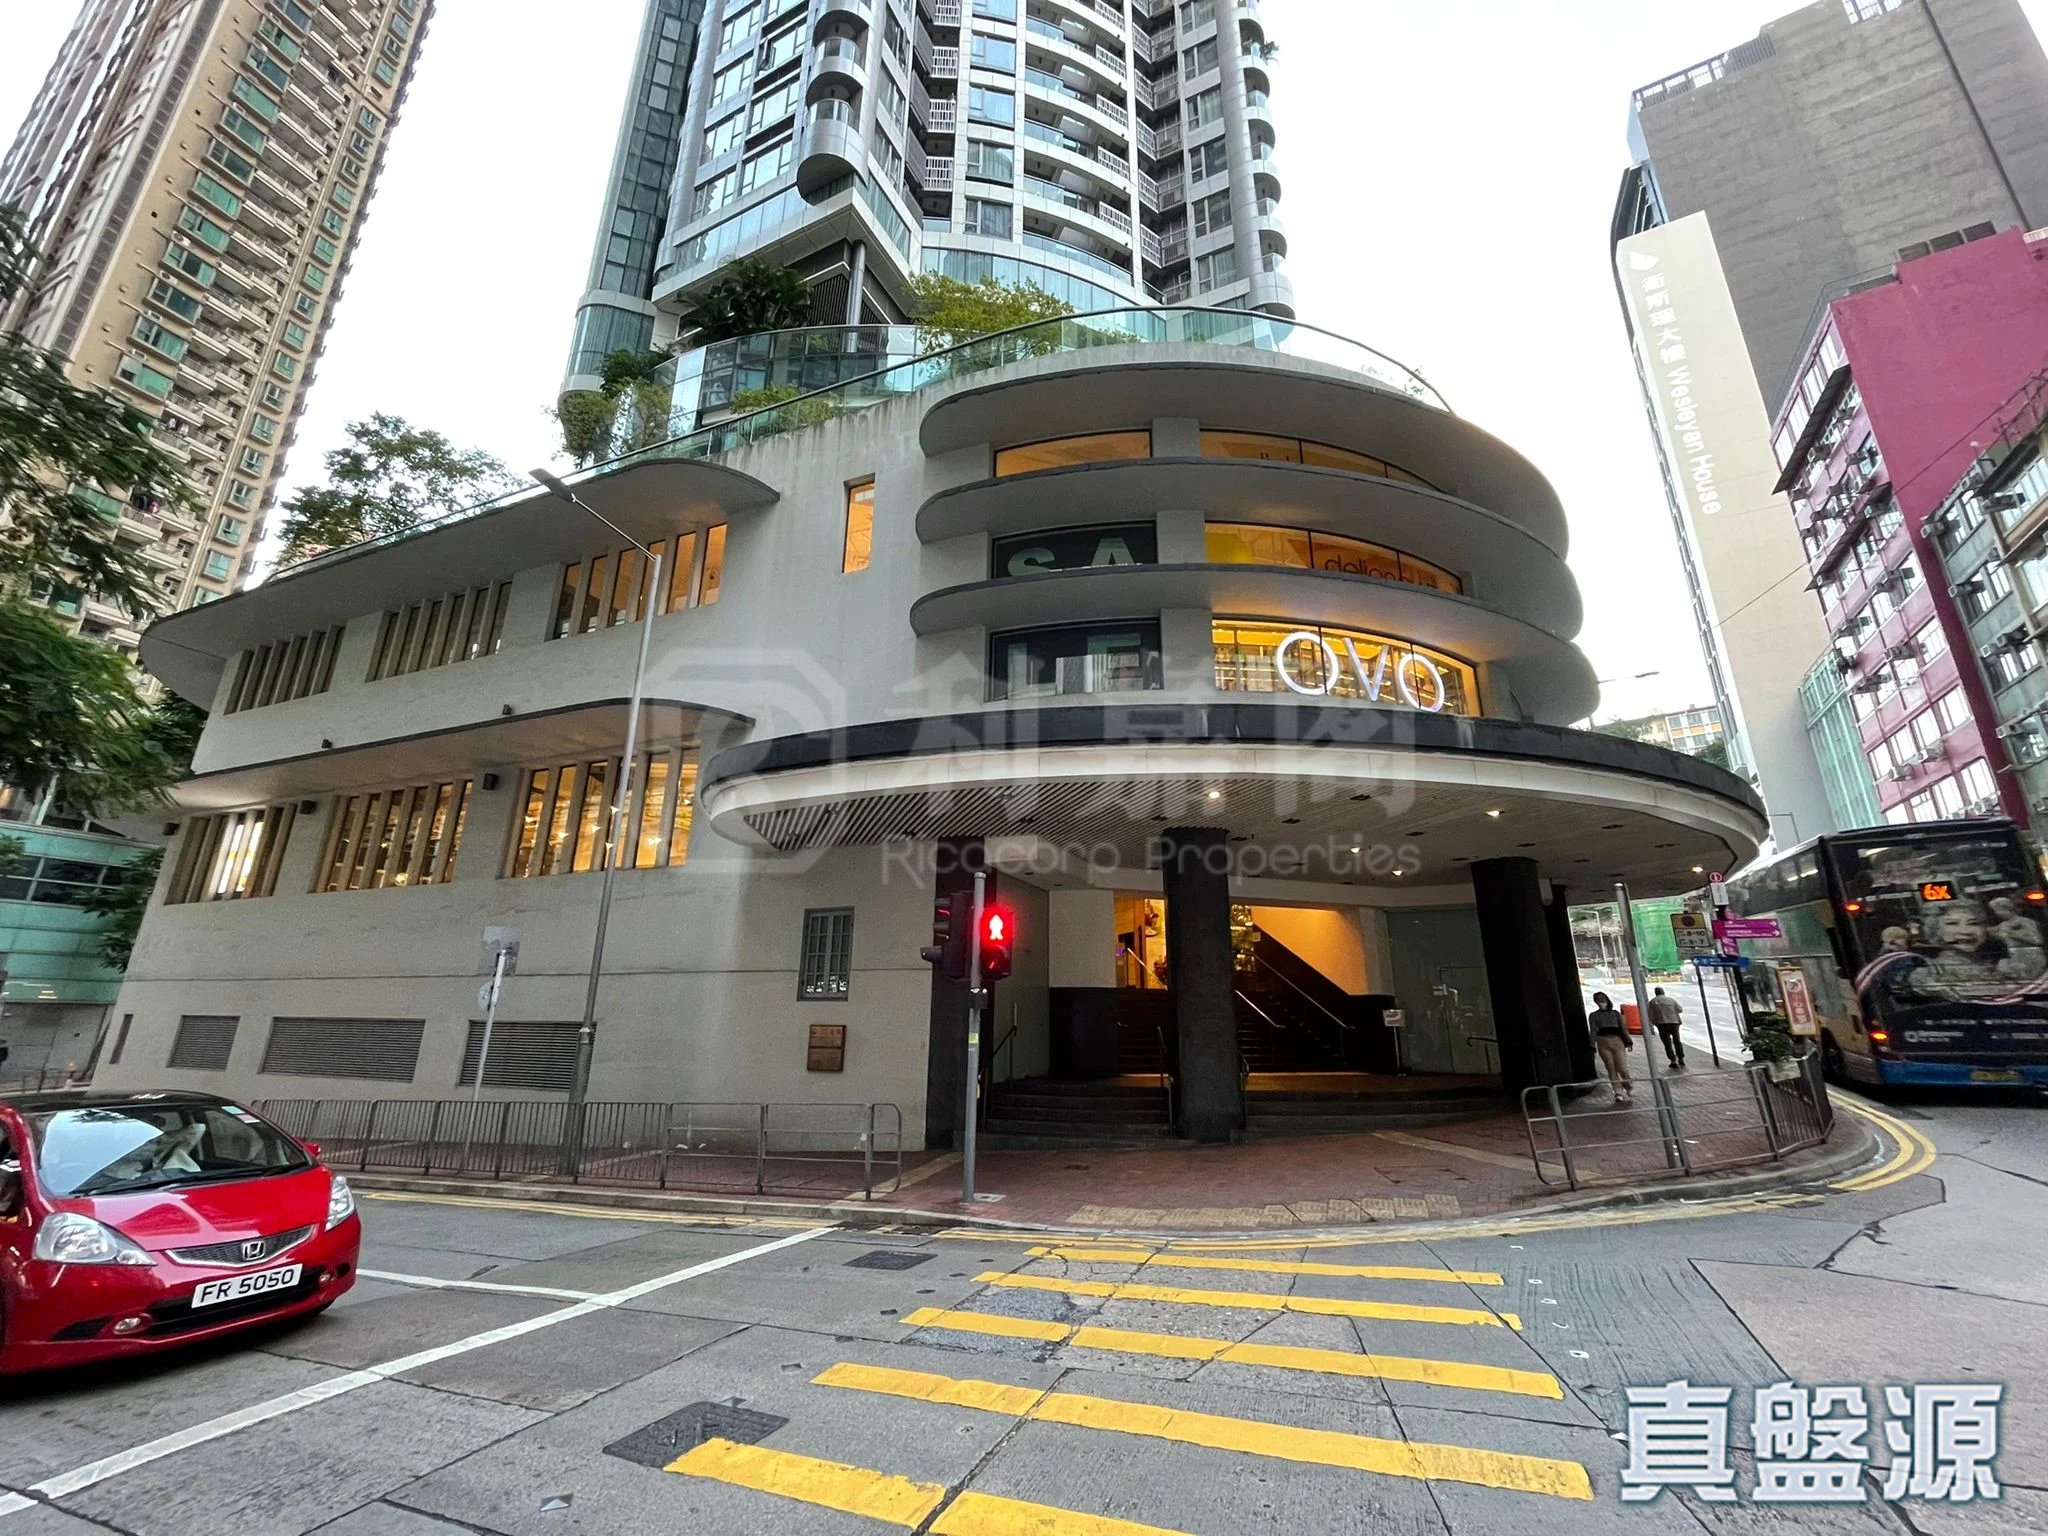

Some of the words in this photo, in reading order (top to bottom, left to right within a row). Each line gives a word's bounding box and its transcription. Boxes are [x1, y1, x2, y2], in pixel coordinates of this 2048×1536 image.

[1667, 366, 1705, 454] Wesleyan
[1691, 454, 1722, 515] House
[1276, 631, 1446, 713] OVO
[1923, 883, 1952, 901] 6X
[200, 1282, 232, 1303] FR
[238, 1269, 294, 1294] 5050
